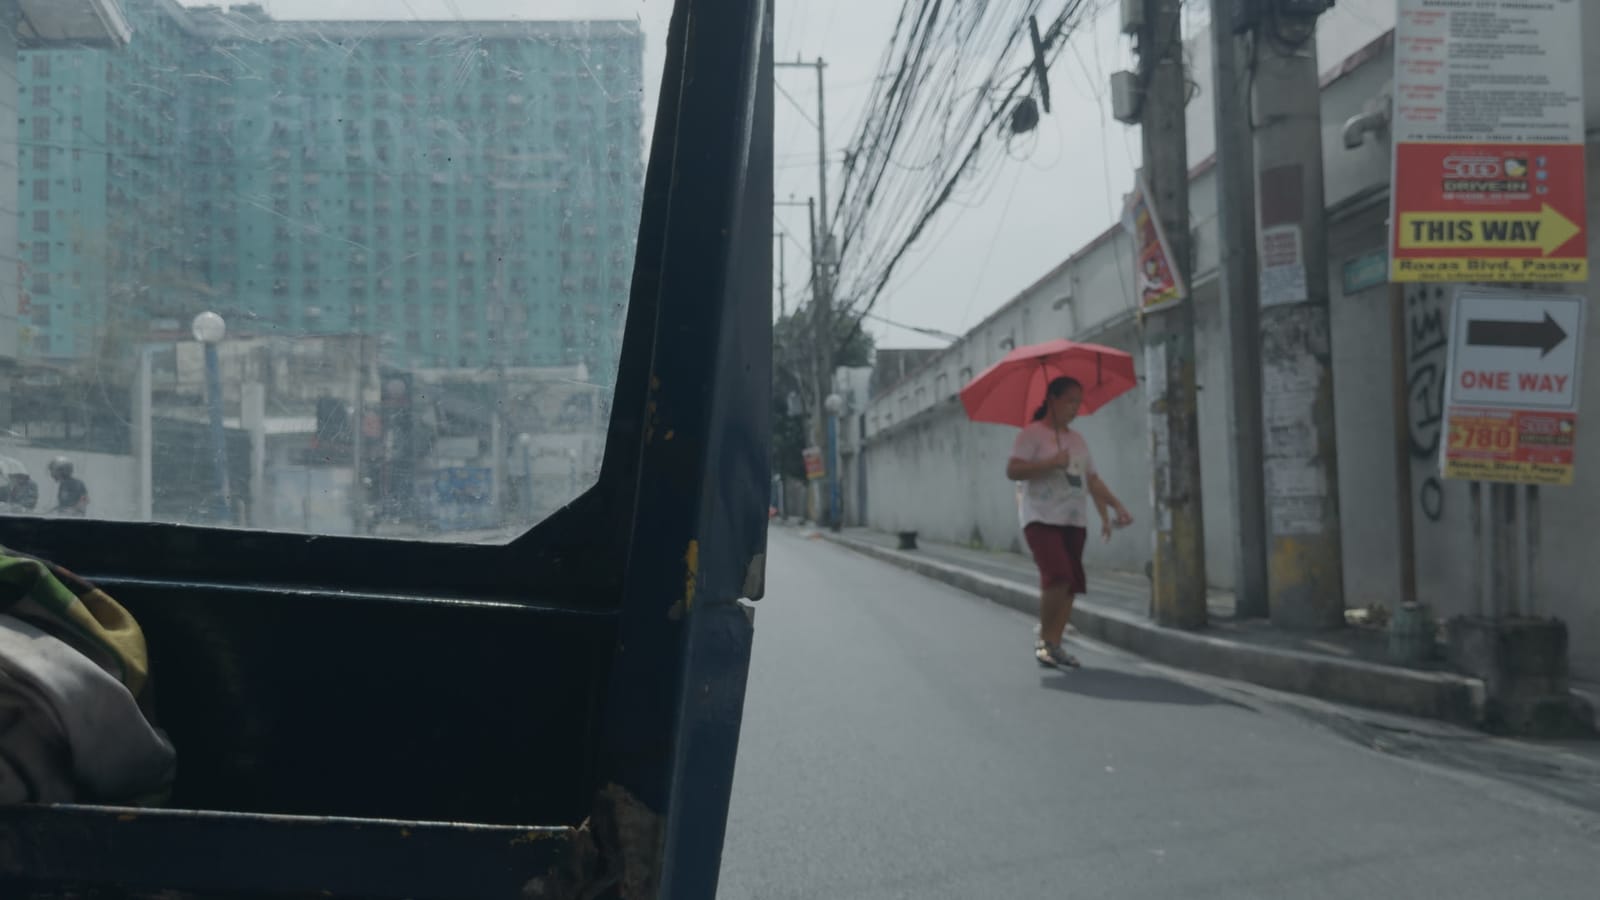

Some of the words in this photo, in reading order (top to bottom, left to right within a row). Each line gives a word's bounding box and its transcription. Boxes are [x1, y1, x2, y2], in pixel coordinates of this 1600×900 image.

[1410, 220, 1474, 242] THIS
[1481, 220, 1541, 242] WAY
[1399, 259, 1460, 270] Roxas
[1522, 259, 1582, 273] Pasay
[1460, 370, 1511, 391] ONE
[1518, 372, 1568, 393] WAY
